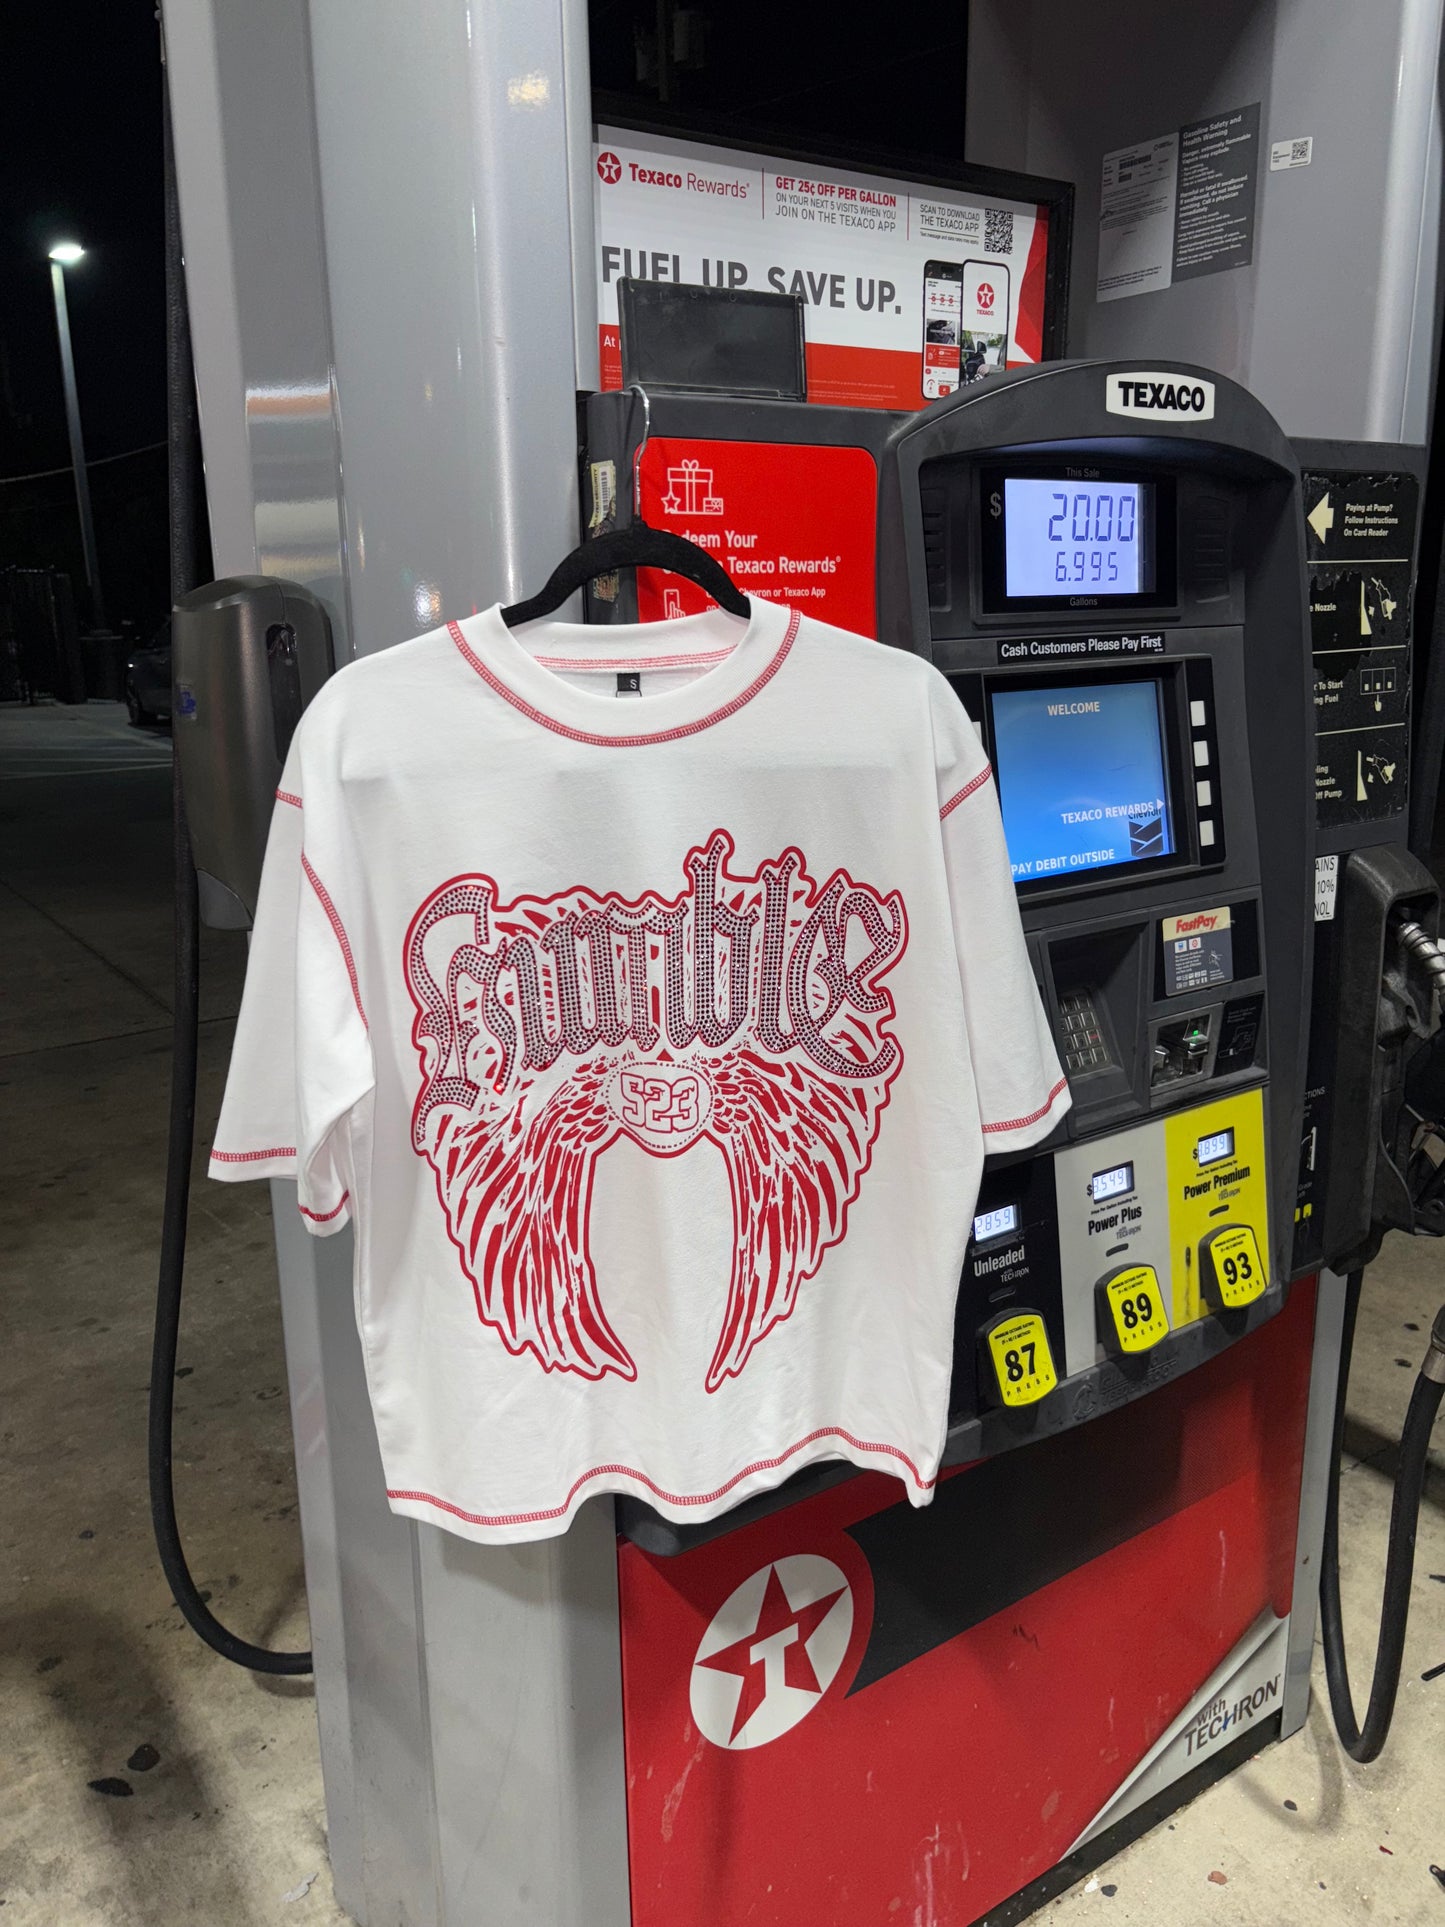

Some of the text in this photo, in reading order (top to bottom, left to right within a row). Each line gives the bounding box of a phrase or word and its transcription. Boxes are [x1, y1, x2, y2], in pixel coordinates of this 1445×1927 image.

[1183, 114, 1242, 139] Gasoline Safety and
[1183, 137, 1202, 147] Health
[1203, 129, 1228, 141] Warning
[629, 163, 682, 188] Texaco
[776, 177, 896, 207] GET 25¢ OFF PER GALLON
[776, 192, 896, 220] ON YOUR NEXT 5 VISITS WHEN YOU
[920, 204, 980, 222] SCAN TO DOWNLOAD
[776, 205, 896, 232] JOIN ON THE TEXACO APP
[920, 215, 980, 232] THE TEXACO APP
[767, 266, 846, 309] SAVE
[856, 277, 902, 315] UP.
[603, 334, 616, 348] At
[1118, 381, 1206, 412] TEXACO
[1066, 467, 1100, 478] This Sale
[990, 491, 1002, 520] $
[1345, 503, 1394, 513] Paying at Pump?
[1048, 493, 1136, 542] 20.00
[1344, 515, 1399, 524] Follow Instructions
[724, 530, 758, 548] Your
[1343, 528, 1389, 537] On Card Reader
[727, 556, 775, 574] Texaco
[1055, 551, 1118, 582] 6.995
[773, 589, 782, 597] or
[783, 587, 810, 597] Texaco
[811, 586, 826, 598] App
[1070, 597, 1098, 607] Gallons
[1314, 603, 1337, 612] Nozzle
[1001, 635, 1162, 658] Cash Customers Please Pay First
[629, 679, 638, 690] S
[1319, 681, 1327, 690] To
[1327, 680, 1344, 690] Start
[1047, 701, 1101, 716] WELCOME
[1324, 694, 1339, 703] Fuel
[1324, 789, 1343, 799] Pump
[1061, 801, 1154, 825] TEXACO REWARDS
[1011, 849, 1115, 876] PAY DEBIT OUTSIDE
[1317, 879, 1335, 895] 10%
[1176, 914, 1218, 934] FastPay
[619, 1071, 701, 1134] 523
[1184, 1180, 1212, 1200] Power
[1213, 1166, 1250, 1190] Premium
[1088, 1206, 1142, 1236] Power Plus
[973, 1244, 1025, 1277] Unleaded
[1223, 1251, 1252, 1286] 93
[1121, 1292, 1153, 1329] 89
[1004, 1341, 1036, 1382] 87
[1006, 1374, 1050, 1398] PRESS
[1197, 1698, 1226, 1727] with
